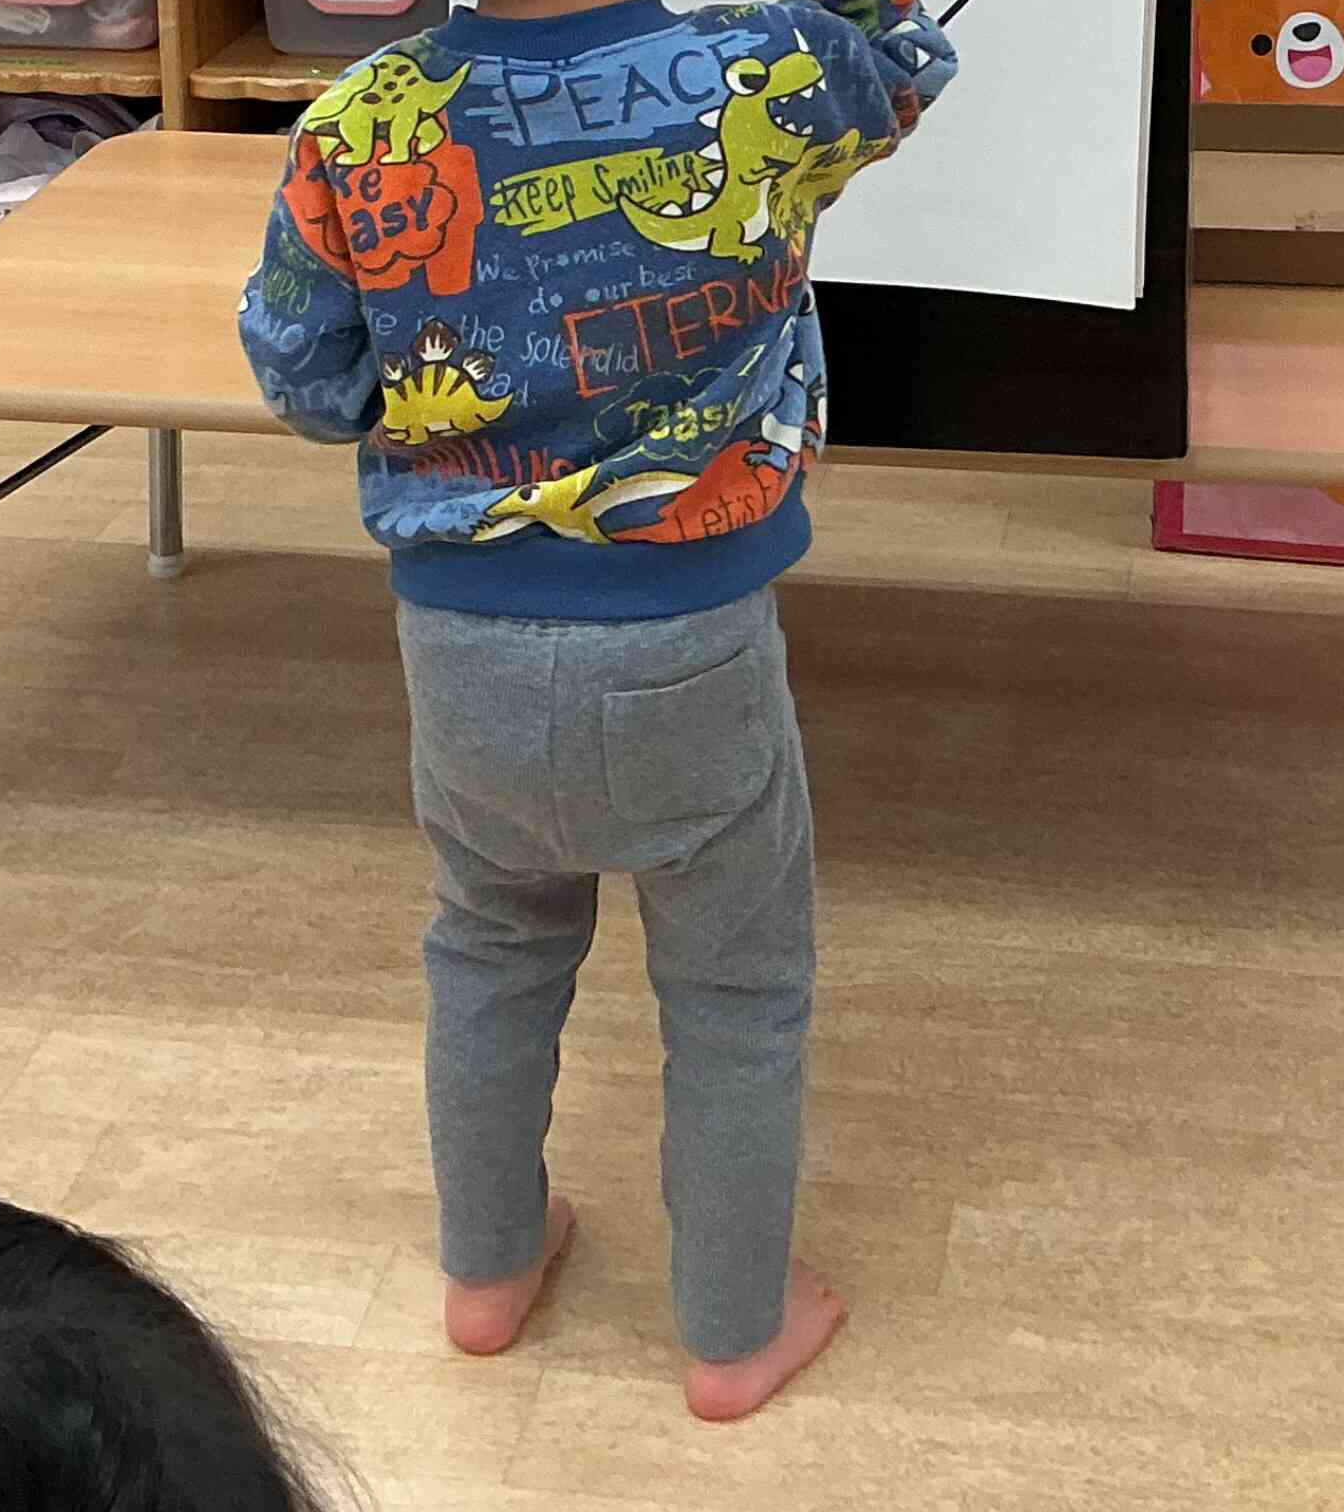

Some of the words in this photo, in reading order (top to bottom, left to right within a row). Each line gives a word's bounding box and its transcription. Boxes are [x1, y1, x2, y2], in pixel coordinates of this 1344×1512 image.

[502, 172, 579, 223] Keep
[638, 263, 697, 289] best
[460, 313, 505, 353] the
